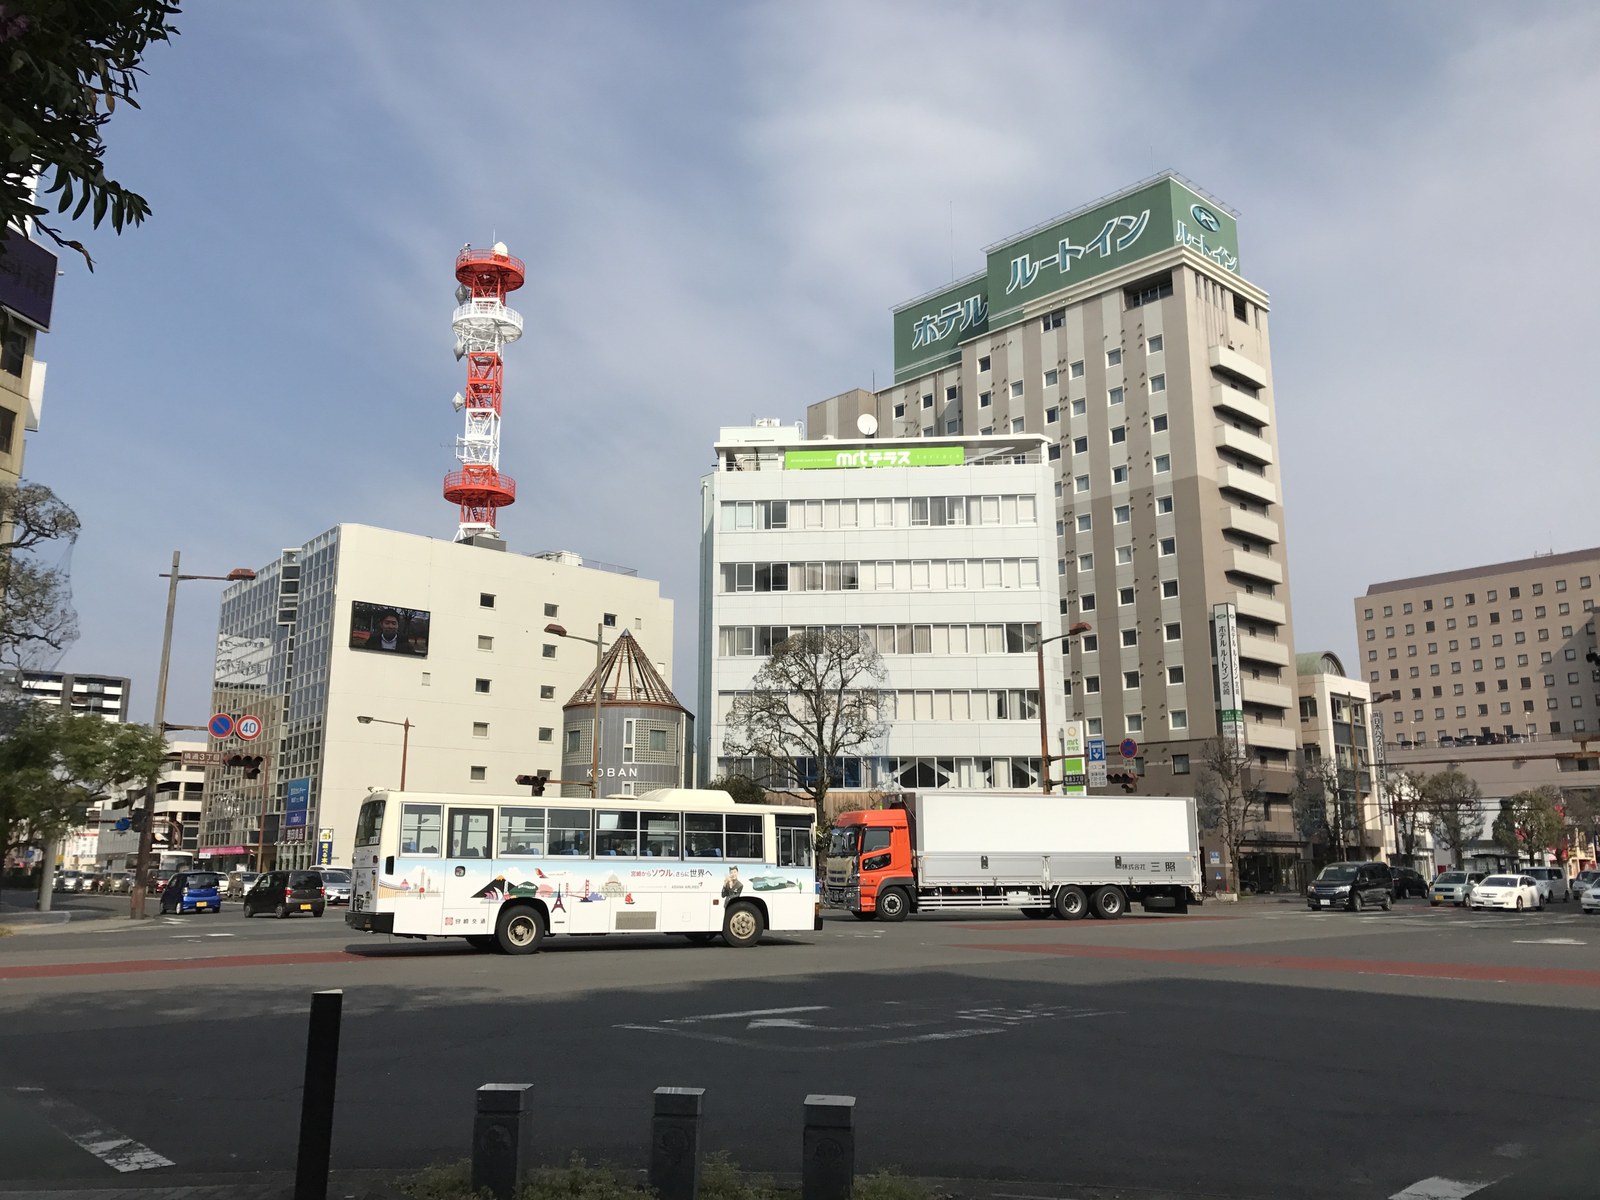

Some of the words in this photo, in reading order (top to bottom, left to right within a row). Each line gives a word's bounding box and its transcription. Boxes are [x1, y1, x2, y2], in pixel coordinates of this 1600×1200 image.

[1006, 208, 1151, 295] ルートイン
[1176, 219, 1238, 272] ルートイン
[912, 293, 989, 351] ホテル
[242, 722, 257, 734] 40
[586, 767, 638, 778] KOBAN
